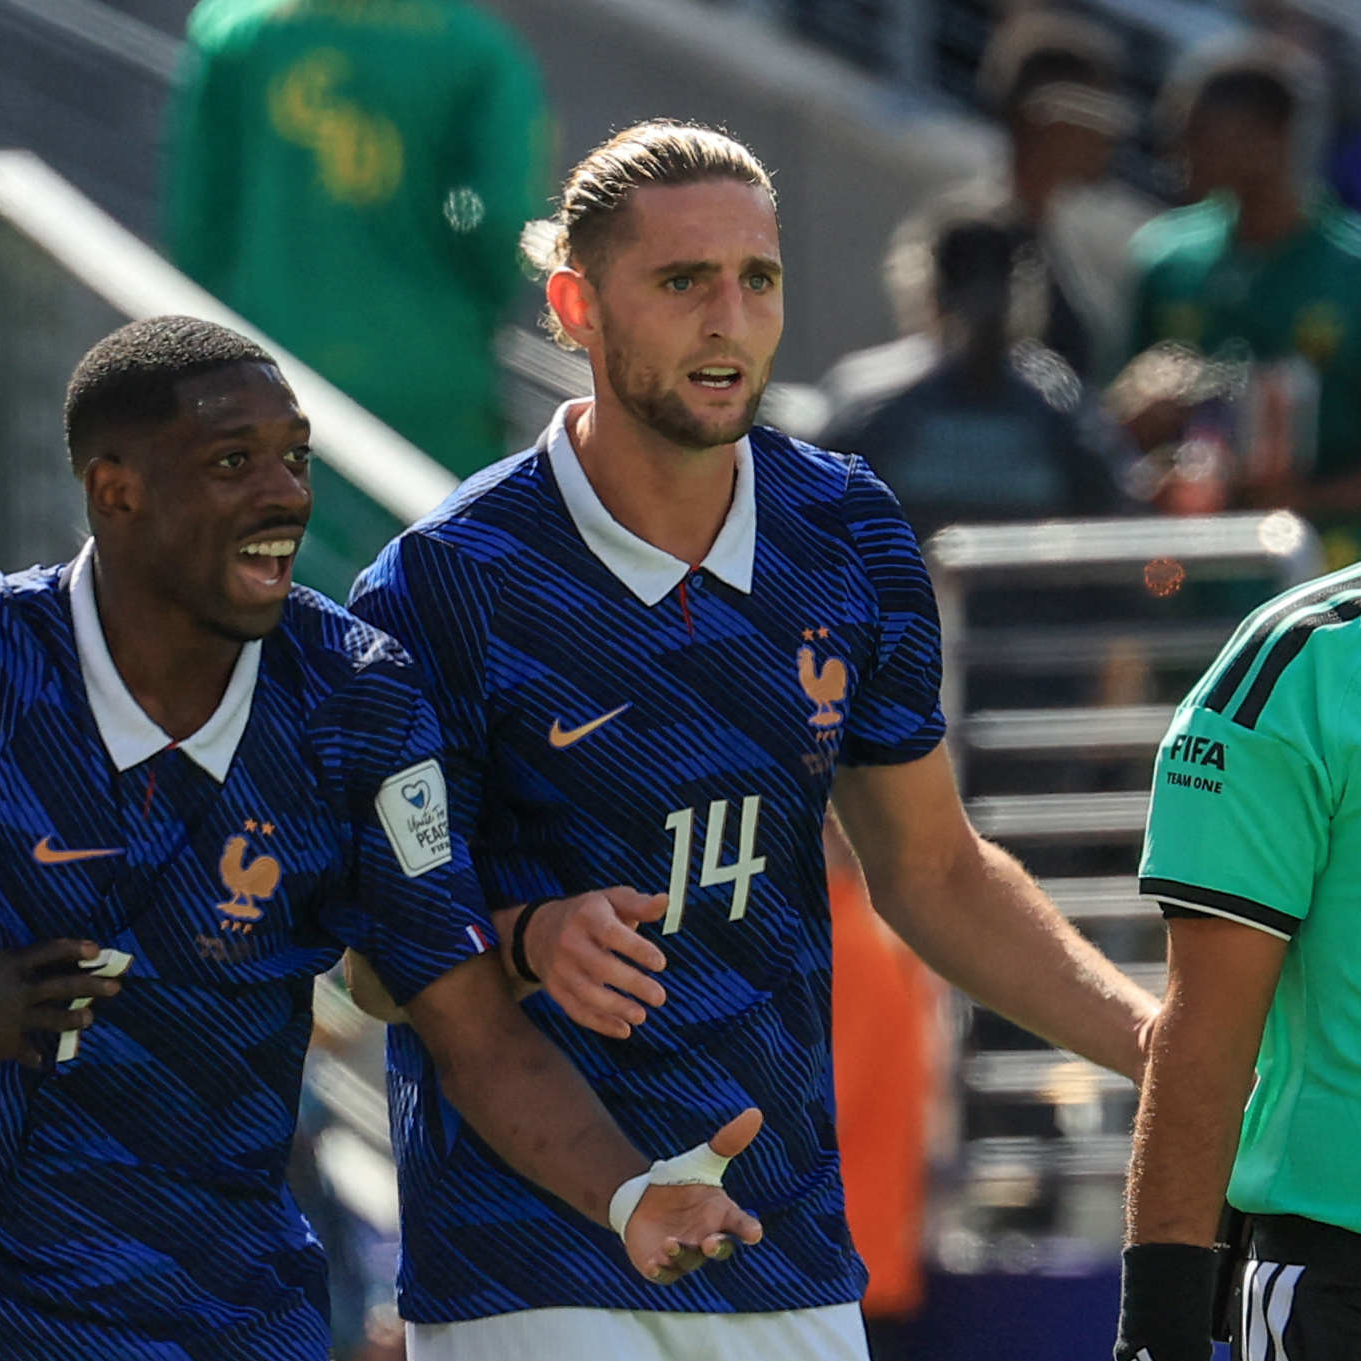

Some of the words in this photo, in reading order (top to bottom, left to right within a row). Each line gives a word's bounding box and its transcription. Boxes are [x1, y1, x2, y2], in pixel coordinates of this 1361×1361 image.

[1170, 734, 1225, 772] FIFA
[1167, 772, 1192, 787] TEAM
[1194, 777, 1223, 794] ONE
[416, 820, 449, 848] PEAC
[662, 794, 766, 936] 14
